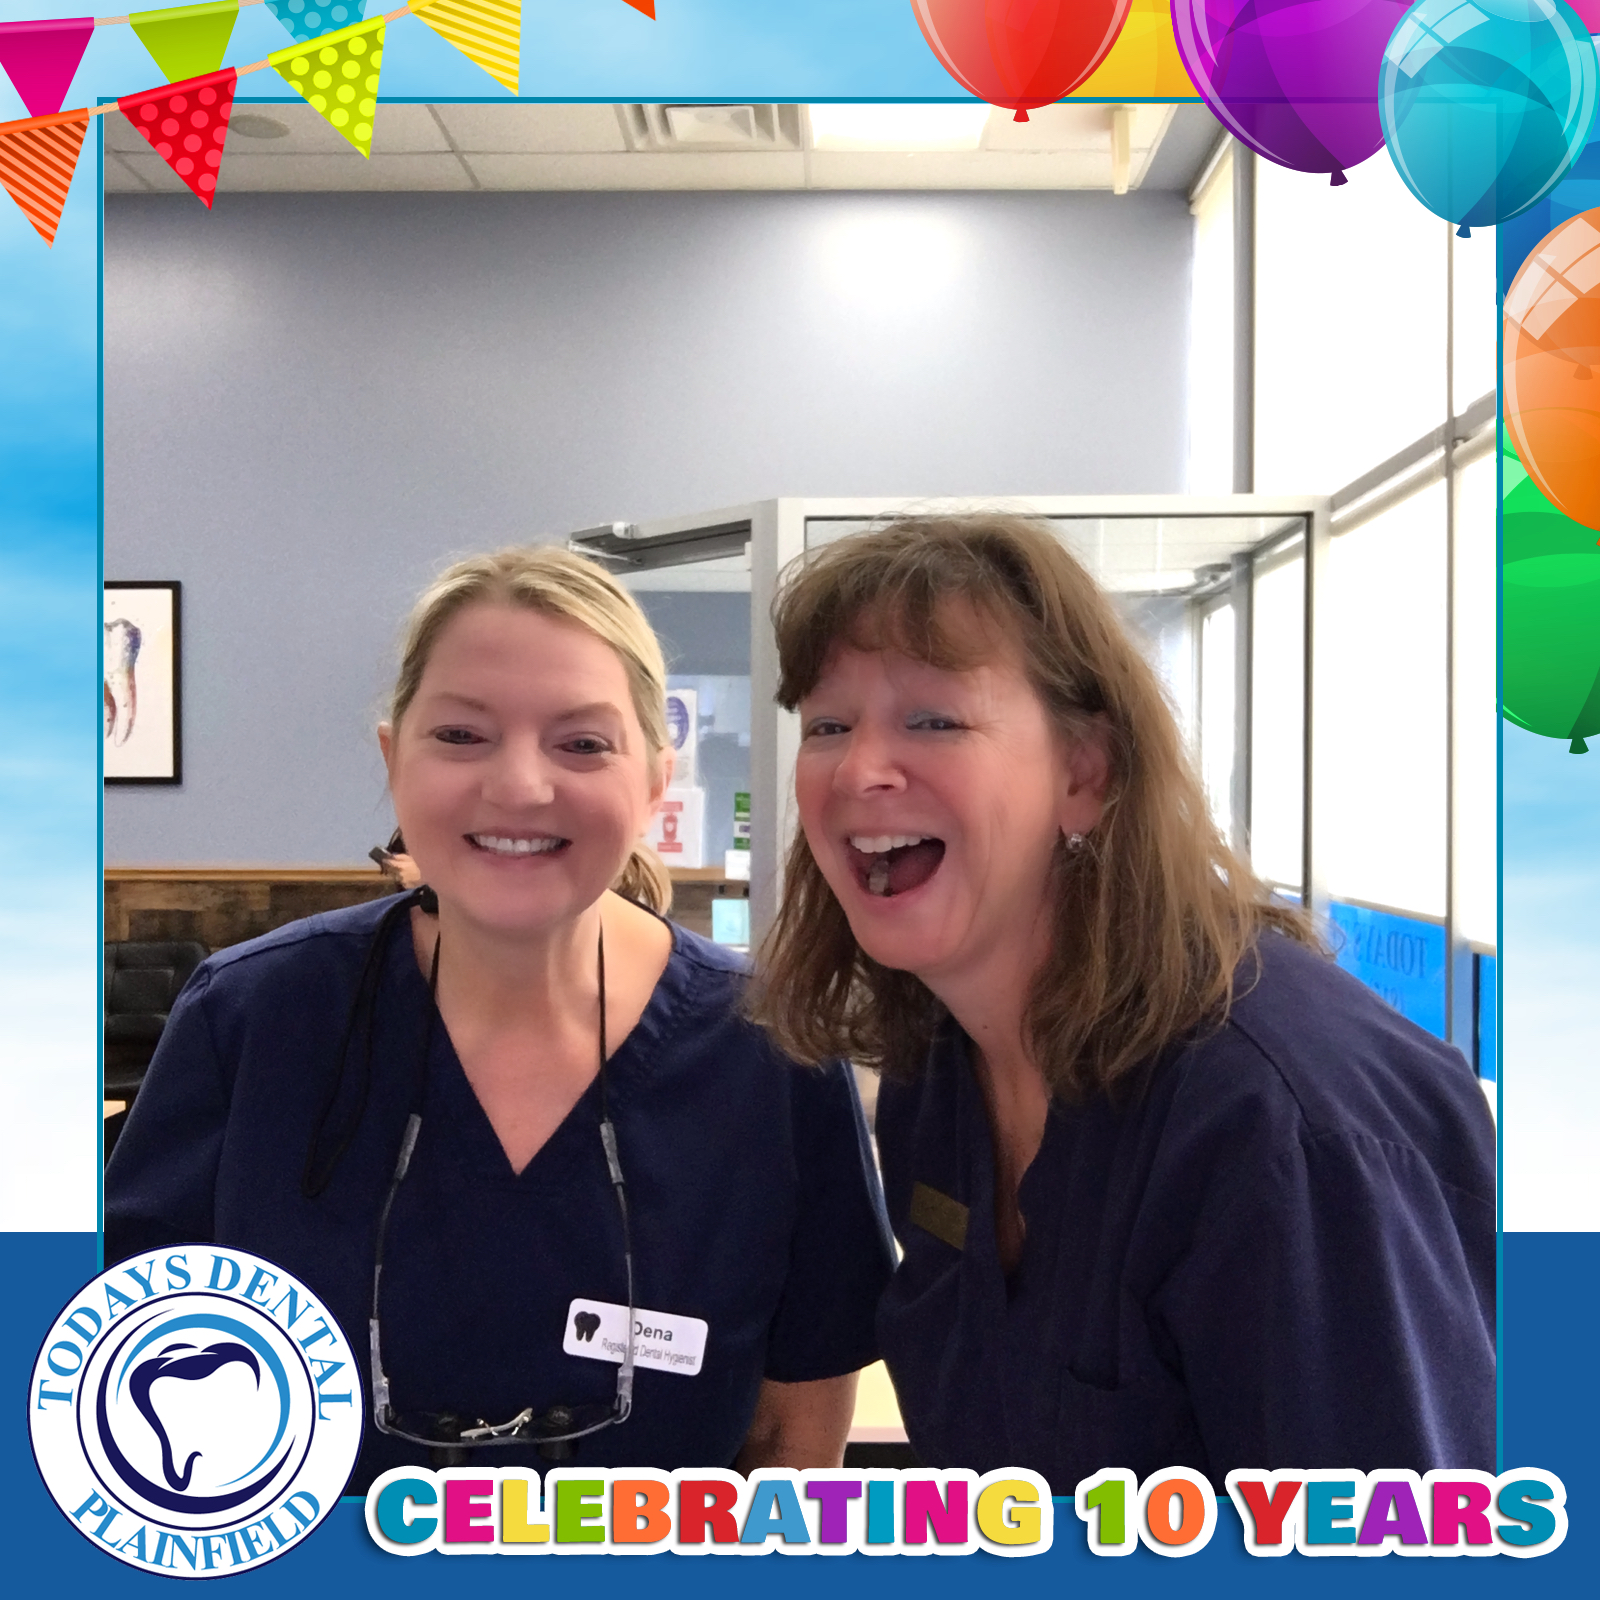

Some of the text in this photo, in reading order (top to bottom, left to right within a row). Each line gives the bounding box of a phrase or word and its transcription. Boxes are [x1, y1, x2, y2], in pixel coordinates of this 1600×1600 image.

[634, 1321, 673, 1342] Dena
[640, 1345, 663, 1359] Dental
[664, 1350, 697, 1366] Hygienist
